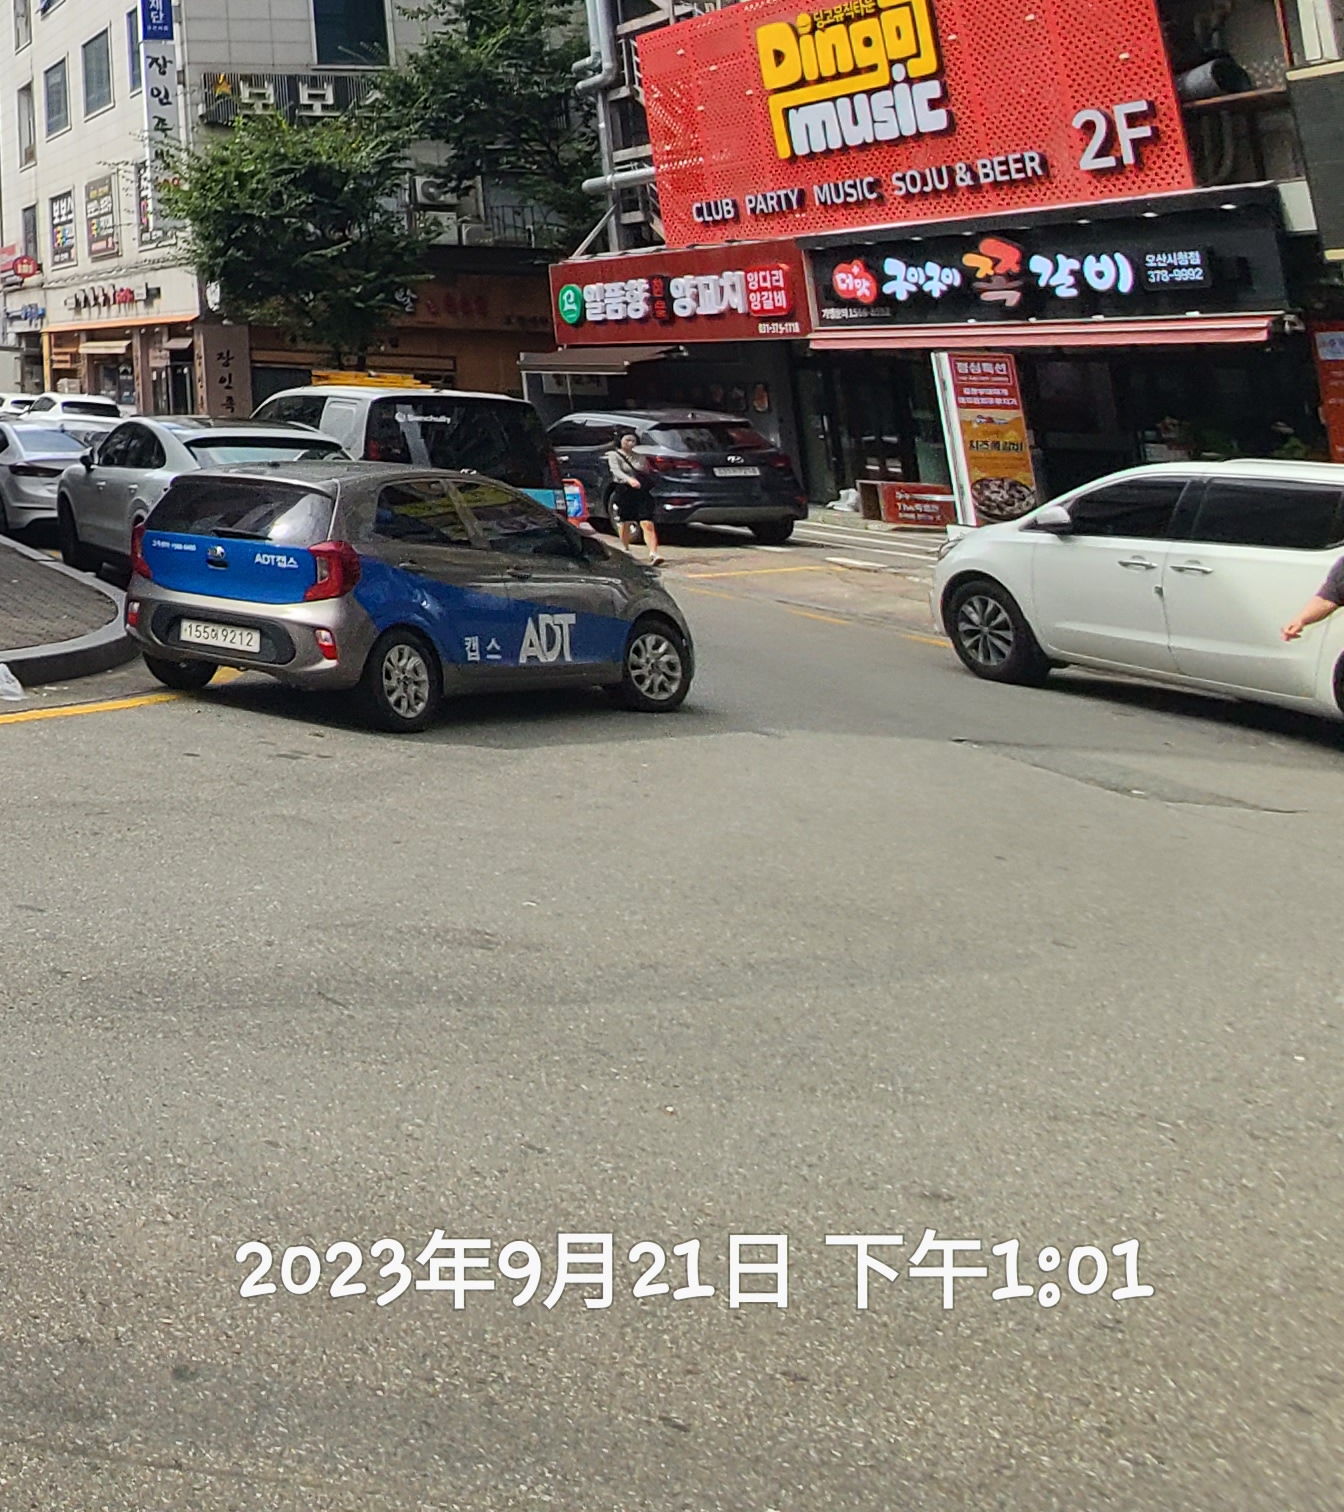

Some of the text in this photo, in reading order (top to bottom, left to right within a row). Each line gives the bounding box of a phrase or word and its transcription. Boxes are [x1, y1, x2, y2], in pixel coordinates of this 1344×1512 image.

[756, 7, 915, 90] Dingo
[787, 64, 948, 157] music
[1072, 99, 1153, 172] 2F
[692, 151, 1043, 223] CLUB PARTY MUSIC SOJU & BEER
[583, 278, 650, 321] 일품향
[882, 257, 962, 301] 구이구이
[255, 553, 299, 568] ADT캡스
[464, 635, 502, 663] 캡스
[519, 612, 577, 664] ADT
